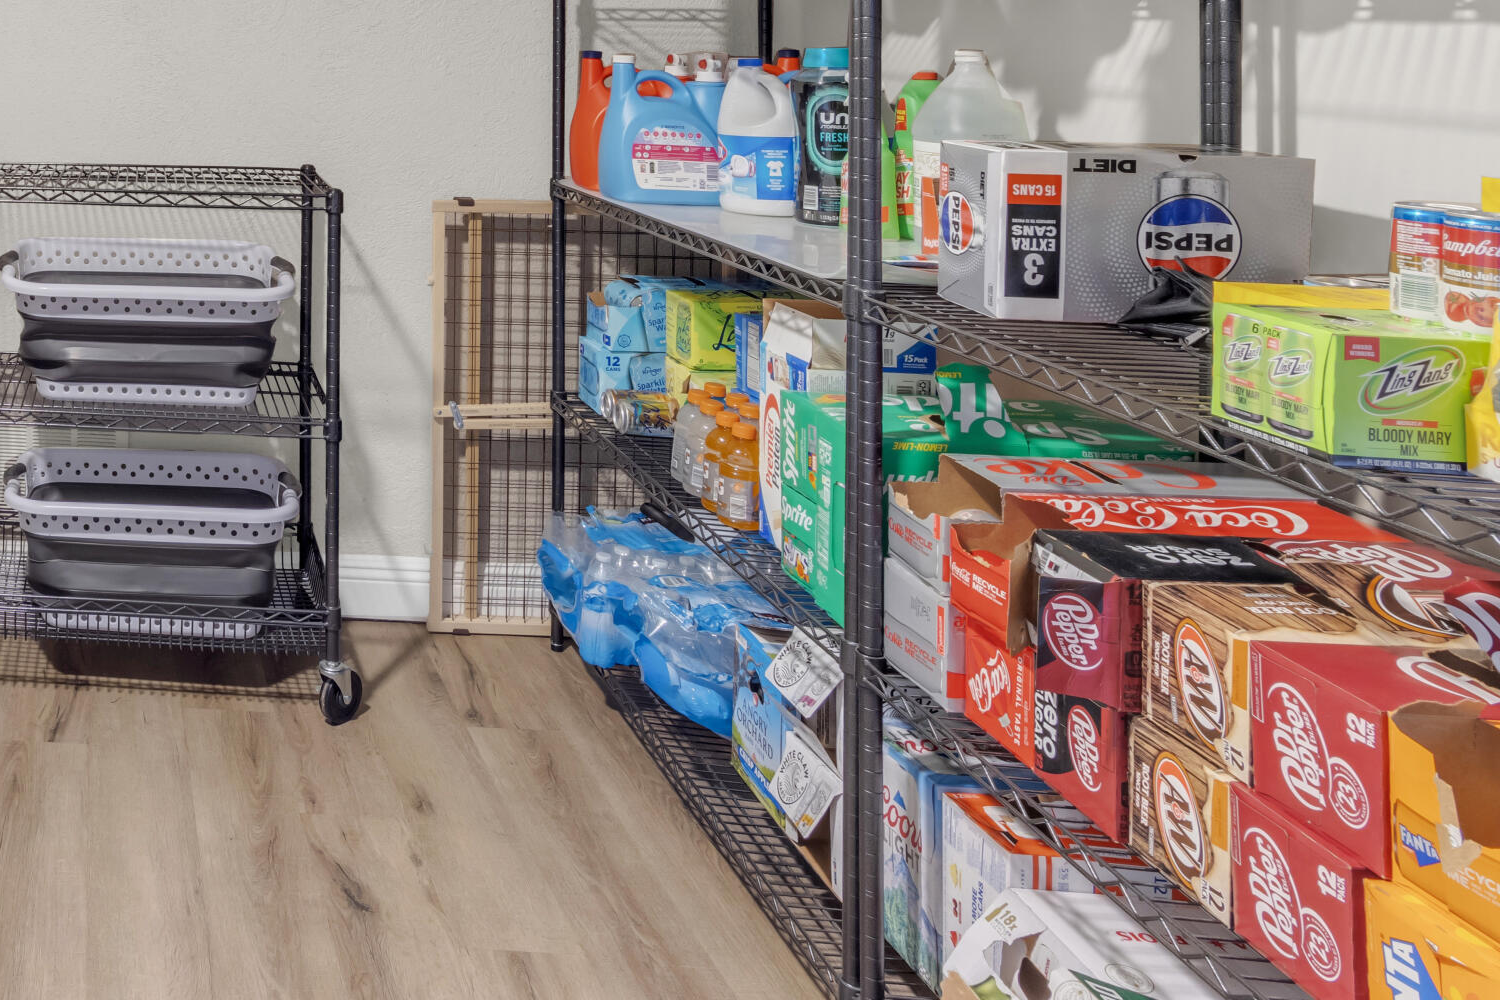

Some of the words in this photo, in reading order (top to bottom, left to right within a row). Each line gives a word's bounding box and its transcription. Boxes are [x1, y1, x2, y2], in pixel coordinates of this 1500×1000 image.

[819, 131, 849, 143] FRESH
[1072, 158, 1137, 174] DIET
[1012, 184, 1043, 196] CANS
[1044, 184, 1057, 197] 15
[951, 196, 961, 252] PEPSI
[1011, 225, 1057, 237] CANS
[1011, 237, 1056, 252] EXTRA
[1145, 231, 1234, 253] PEPSI
[1023, 252, 1045, 286] 3
[1251, 322, 1259, 334] 6
[1262, 326, 1282, 339] PACK
[605, 356, 621, 367] 12
[903, 354, 914, 363] 15
[1370, 363, 1418, 401] Zing
[1406, 358, 1455, 393] Zang
[764, 416, 775, 489] Premier
[782, 398, 800, 488] Sprite
[892, 441, 949, 453] LEMON-LIME
[1368, 427, 1414, 443] BLOODY
[1417, 429, 1453, 446] MARY
[1399, 445, 1419, 457] MIX
[772, 426, 781, 490] Protein
[1020, 475, 1087, 488] Diet
[780, 494, 813, 532] Sprite
[888, 516, 905, 539] Coke
[904, 526, 933, 552] RECYCLE
[904, 534, 914, 547] ME
[1124, 544, 1231, 557] SUGAR
[971, 573, 1008, 601] RECYCLE
[971, 582, 985, 595] ME
[1243, 606, 1294, 615] BEER
[884, 624, 904, 650] Coke
[904, 637, 937, 667] RECYCLE
[1050, 594, 1096, 667] Pepper
[1073, 621, 1101, 651] Dr
[776, 639, 802, 661] WHITE
[801, 640, 813, 665] CLAW
[904, 645, 916, 659] ME
[1160, 630, 1171, 665] ROOT
[1014, 656, 1024, 708] ORIGINAL
[1159, 664, 1170, 697] BEER
[1180, 637, 1225, 734] A&W
[741, 695, 769, 737] ANGRY
[1012, 711, 1022, 748] TASTE
[1034, 692, 1045, 751] UGAR
[1042, 688, 1058, 760] zero
[1345, 711, 1367, 745] 12
[736, 707, 774, 760] ORCHARD
[1070, 707, 1097, 787] Pepper
[1272, 711, 1301, 760] Dr
[1365, 720, 1376, 749] PACK
[739, 747, 755, 772] CRISP
[779, 749, 797, 774] WHITE
[796, 750, 810, 780] CLAW
[1082, 741, 1101, 774] Dr
[1228, 744, 1245, 772] 12
[1280, 690, 1328, 812] Pepper
[1141, 761, 1150, 796] ROOT
[1140, 795, 1149, 827] BEER
[1336, 780, 1359, 812] 23
[1158, 770, 1203, 871] A&W
[1399, 825, 1440, 861] FANTA
[1154, 875, 1169, 895] 12
[1248, 854, 1273, 904] Dr
[1316, 864, 1337, 898] 12
[1335, 876, 1346, 904] PACK
[1208, 885, 1226, 913] 12
[1255, 836, 1300, 960] Pepper
[1000, 909, 1019, 932] 18x
[1309, 931, 1331, 964] 23
